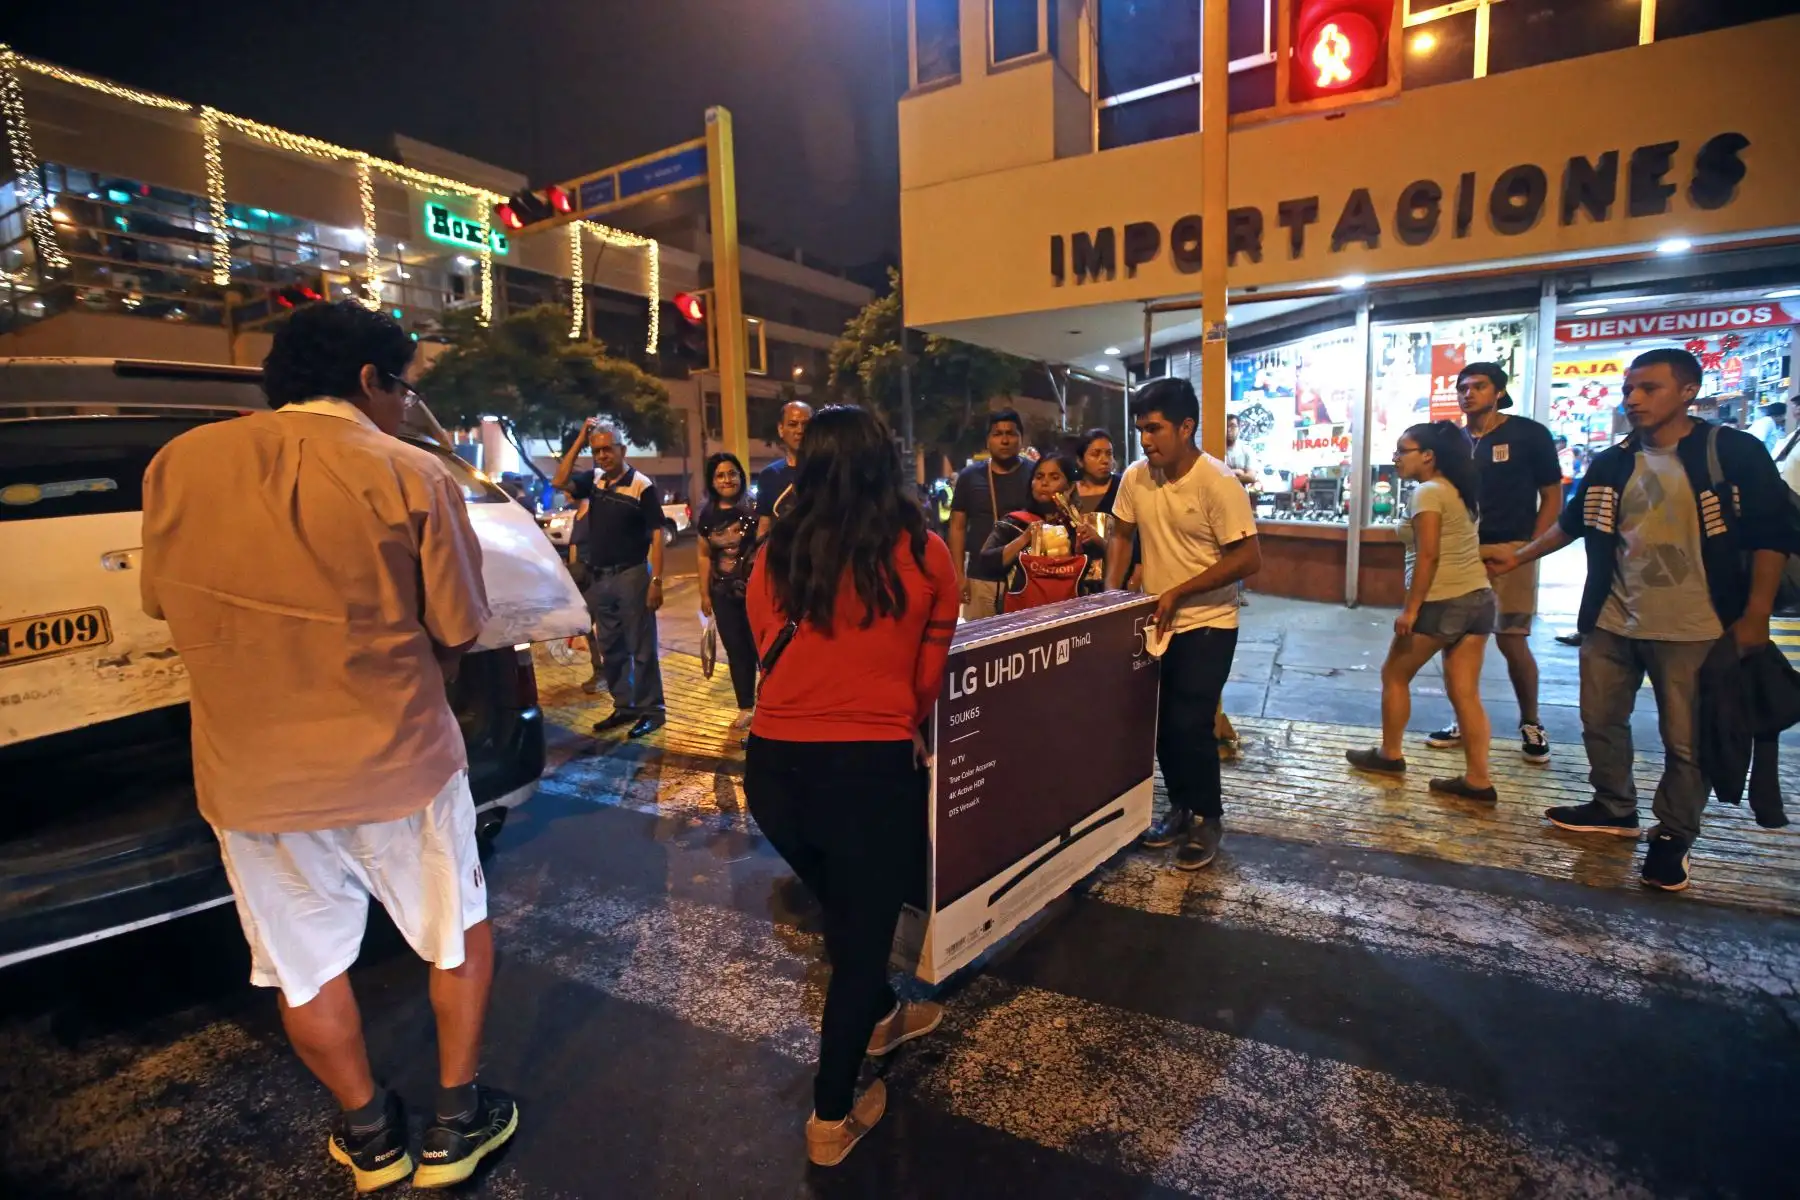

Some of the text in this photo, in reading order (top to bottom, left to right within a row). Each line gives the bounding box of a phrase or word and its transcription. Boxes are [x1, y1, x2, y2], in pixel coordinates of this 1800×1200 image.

[1571, 307, 1772, 338] BIENVENIDOS
[949, 632, 1092, 700] LG UHD TV AI ThinQ
[949, 706, 980, 727] 50UK65
[957, 754, 966, 764] TV
[949, 759, 997, 785] True Color Accuracy
[949, 778, 985, 800] 4K Active HDR
[948, 806, 960, 818] DTS
